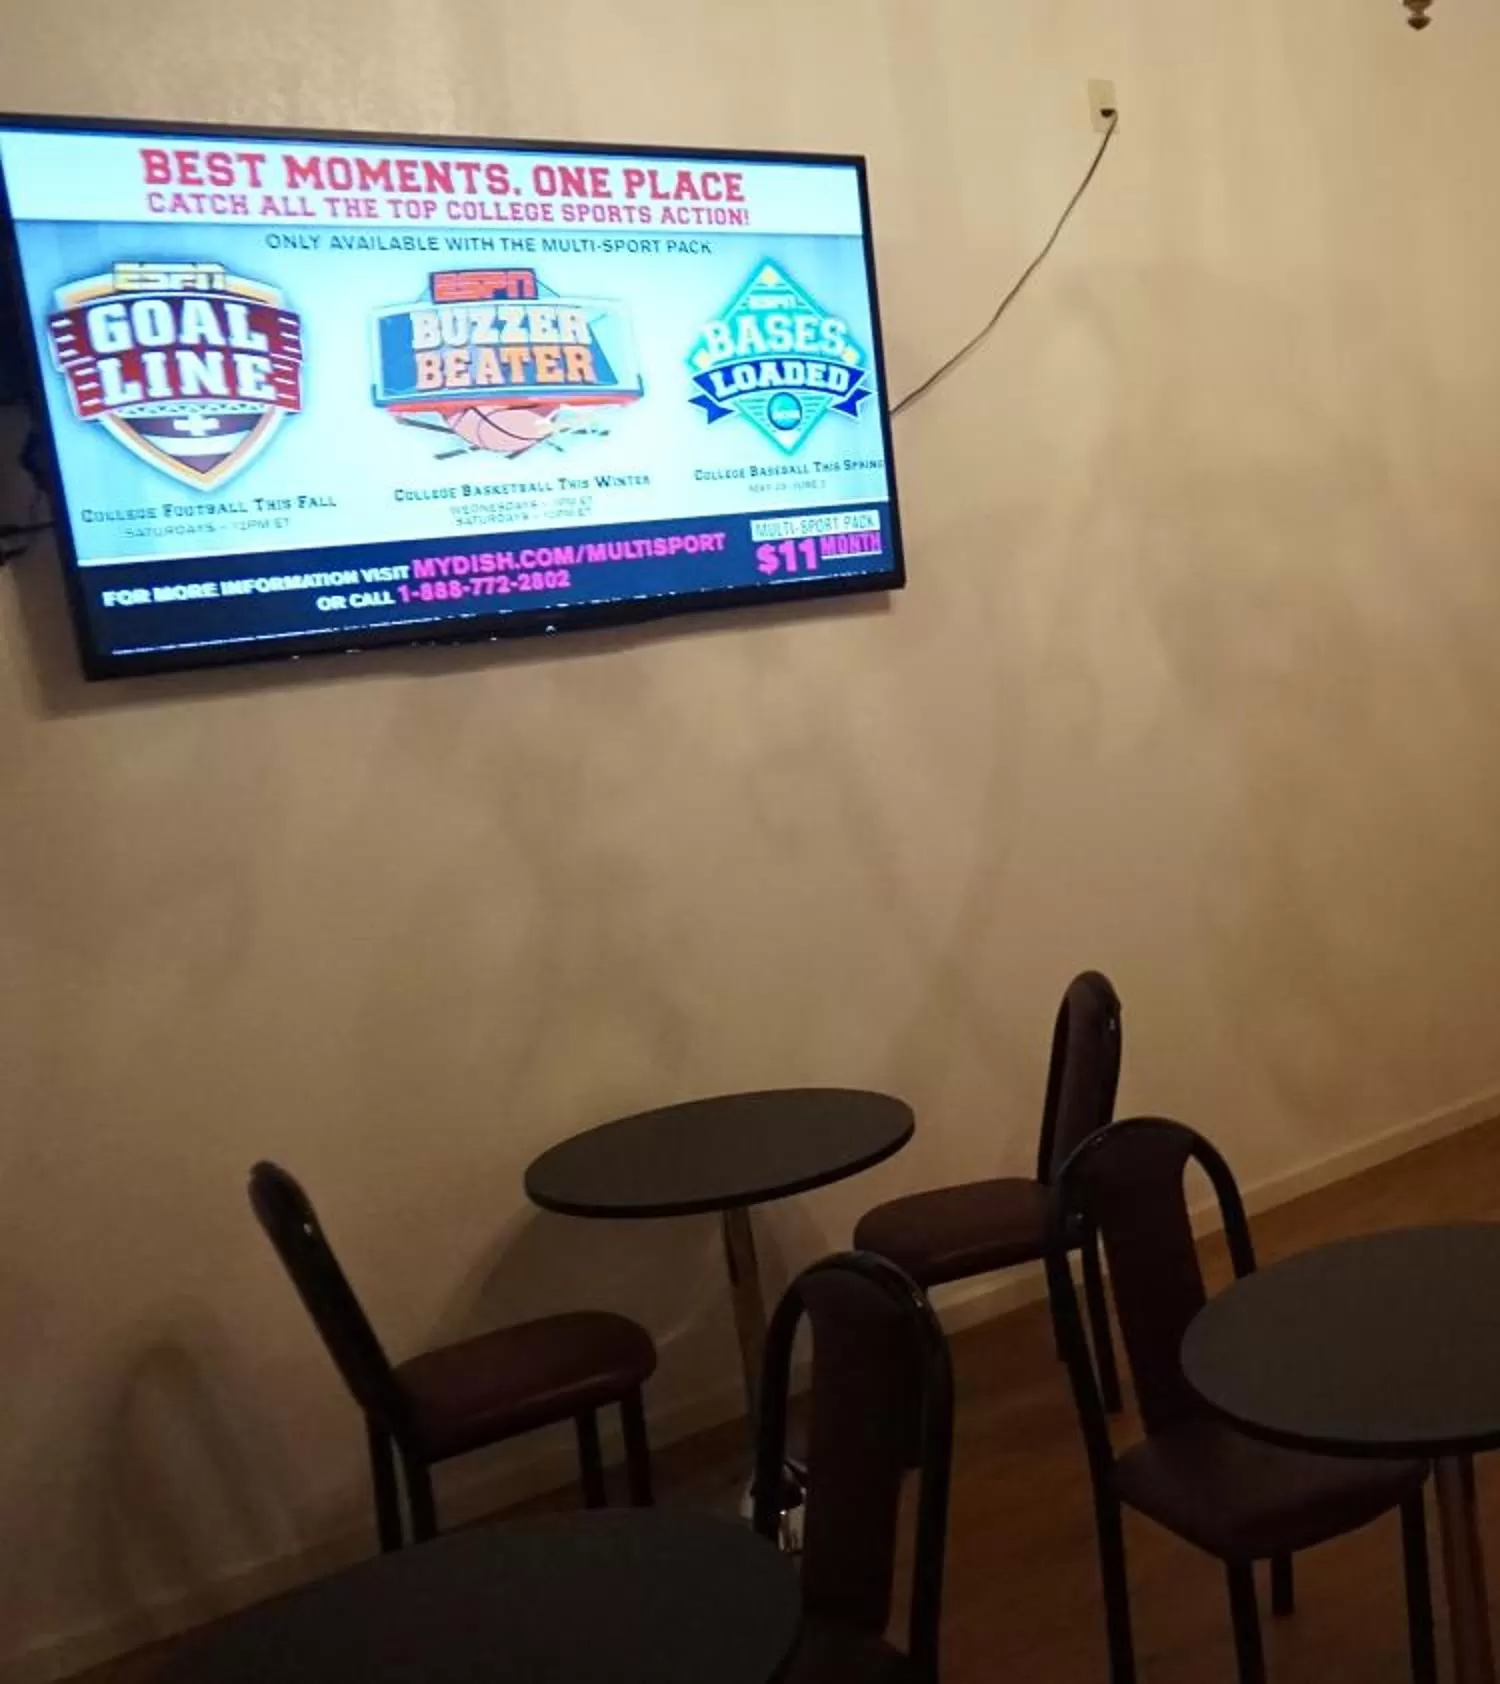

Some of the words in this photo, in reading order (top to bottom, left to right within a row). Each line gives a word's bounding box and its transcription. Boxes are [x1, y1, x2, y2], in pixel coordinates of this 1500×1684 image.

[140, 148, 266, 188] BEST
[531, 164, 612, 199] ONE
[622, 168, 746, 202] PLACE
[147, 192, 250, 215] CATCH
[259, 195, 316, 217] ALL
[324, 197, 378, 218] THE
[386, 198, 438, 219] TOP
[447, 201, 553, 222] COLLEGE
[562, 204, 652, 224] SPORTS
[660, 206, 750, 226] ACTION!
[265, 233, 320, 249] ONLY
[330, 235, 440, 251] AVAILABLE
[444, 237, 494, 251] WITH
[499, 237, 535, 251] THE
[542, 238, 661, 253] MULTI-SPORT
[667, 240, 712, 254] PACK
[113, 262, 225, 291] ESPN
[433, 270, 537, 301] ESPN
[87, 299, 269, 353] GOAL
[410, 306, 592, 350] BUZZER
[703, 314, 849, 357] BASES
[96, 350, 278, 406] LINE
[415, 346, 597, 390] BEATER
[709, 360, 850, 399] LOADED
[755, 517, 838, 537] MULTI-SPORT
[843, 514, 874, 529] PACK
[102, 588, 152, 607] FOR
[152, 582, 219, 602] MORE
[220, 570, 360, 597] INFORMATION
[360, 565, 409, 584] VISIT
[411, 532, 726, 578] MYDISH.COM/MULTISPORT
[756, 536, 818, 575] $11
[819, 531, 881, 555] MONTH
[316, 595, 346, 611] OR
[349, 591, 396, 608] CALL
[398, 570, 571, 603] 1-888-772-2802
